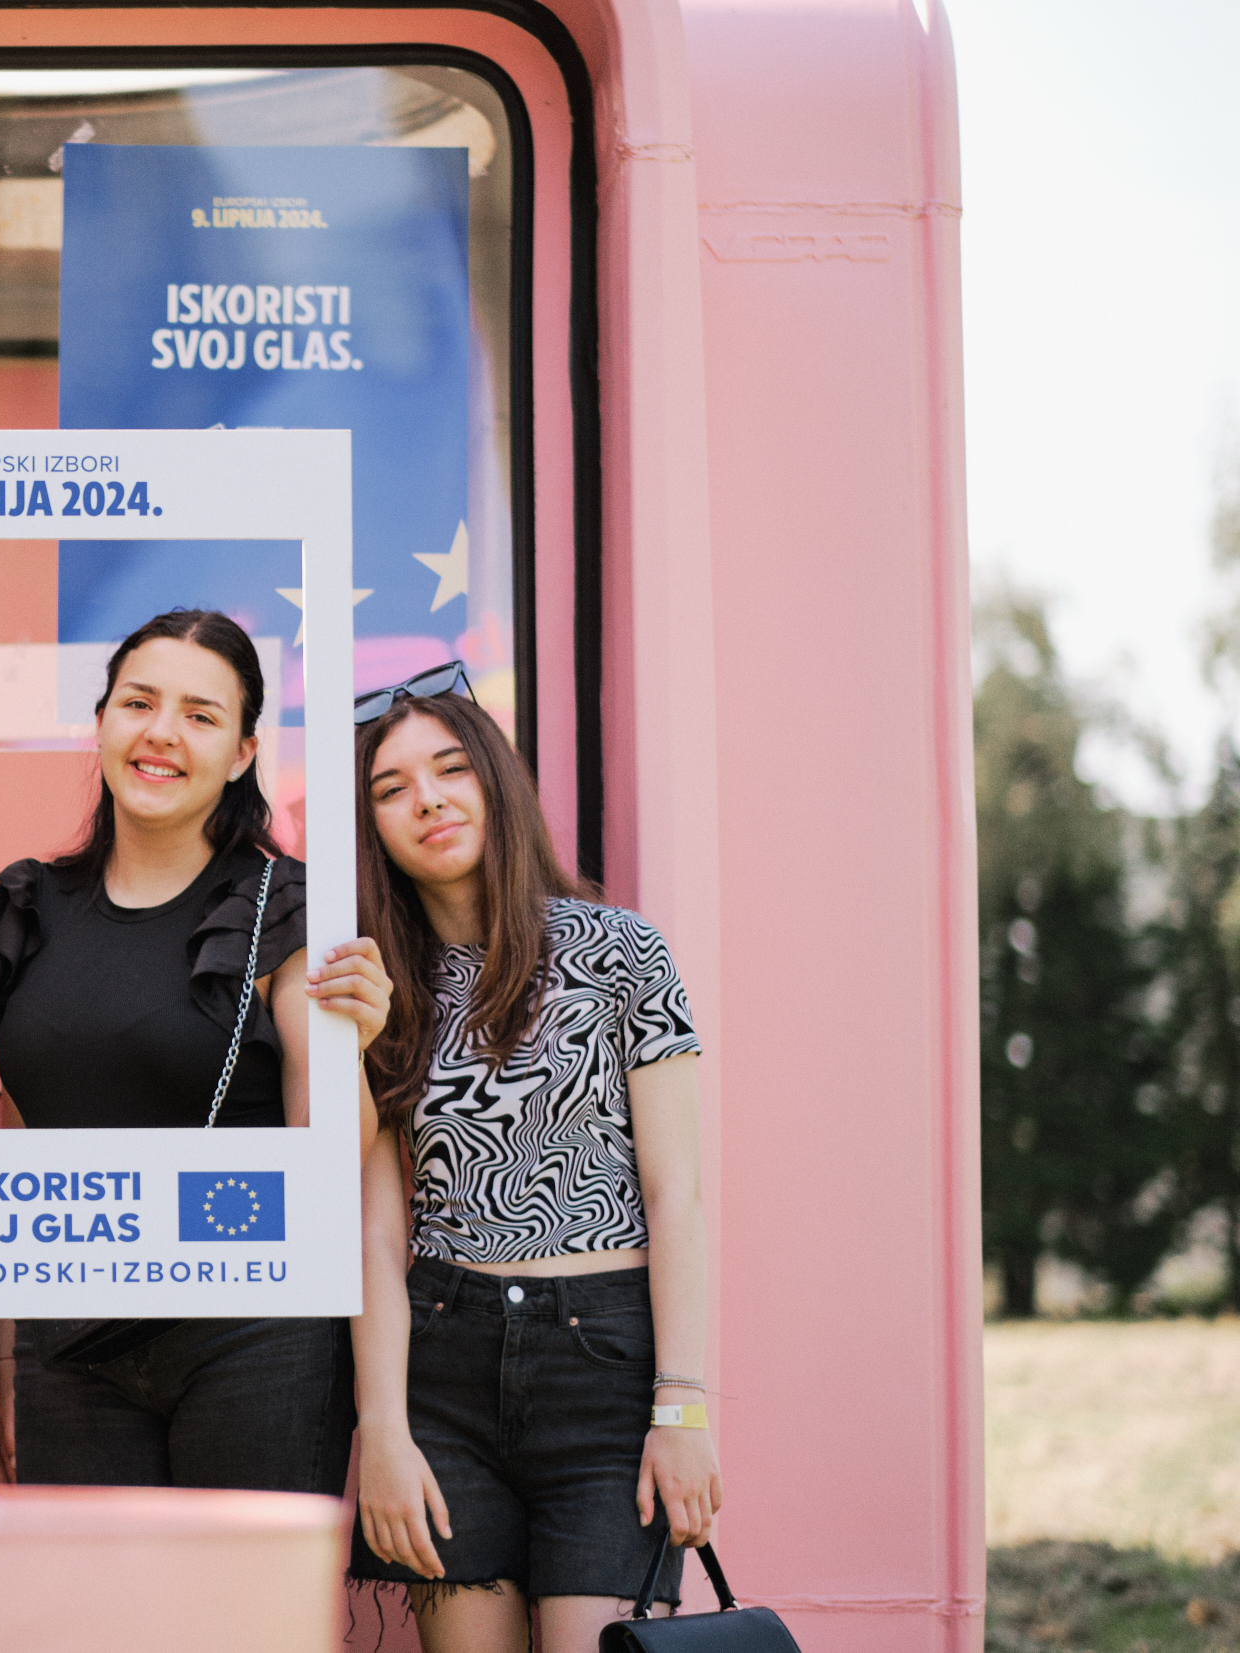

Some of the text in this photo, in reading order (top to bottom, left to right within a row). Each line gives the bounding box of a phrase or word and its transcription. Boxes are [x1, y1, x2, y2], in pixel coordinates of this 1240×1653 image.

[213, 197, 308, 207] EUROPSKI IZBORI
[191, 208, 329, 229] 9. LIPNJA 2024.
[166, 284, 351, 325] ISKORISTI
[151, 328, 363, 371] SVOJ GLAS.
[45, 455, 119, 472] IZBORI
[61, 481, 163, 517] 2024.
[31, 1213, 141, 1243] GLAS
